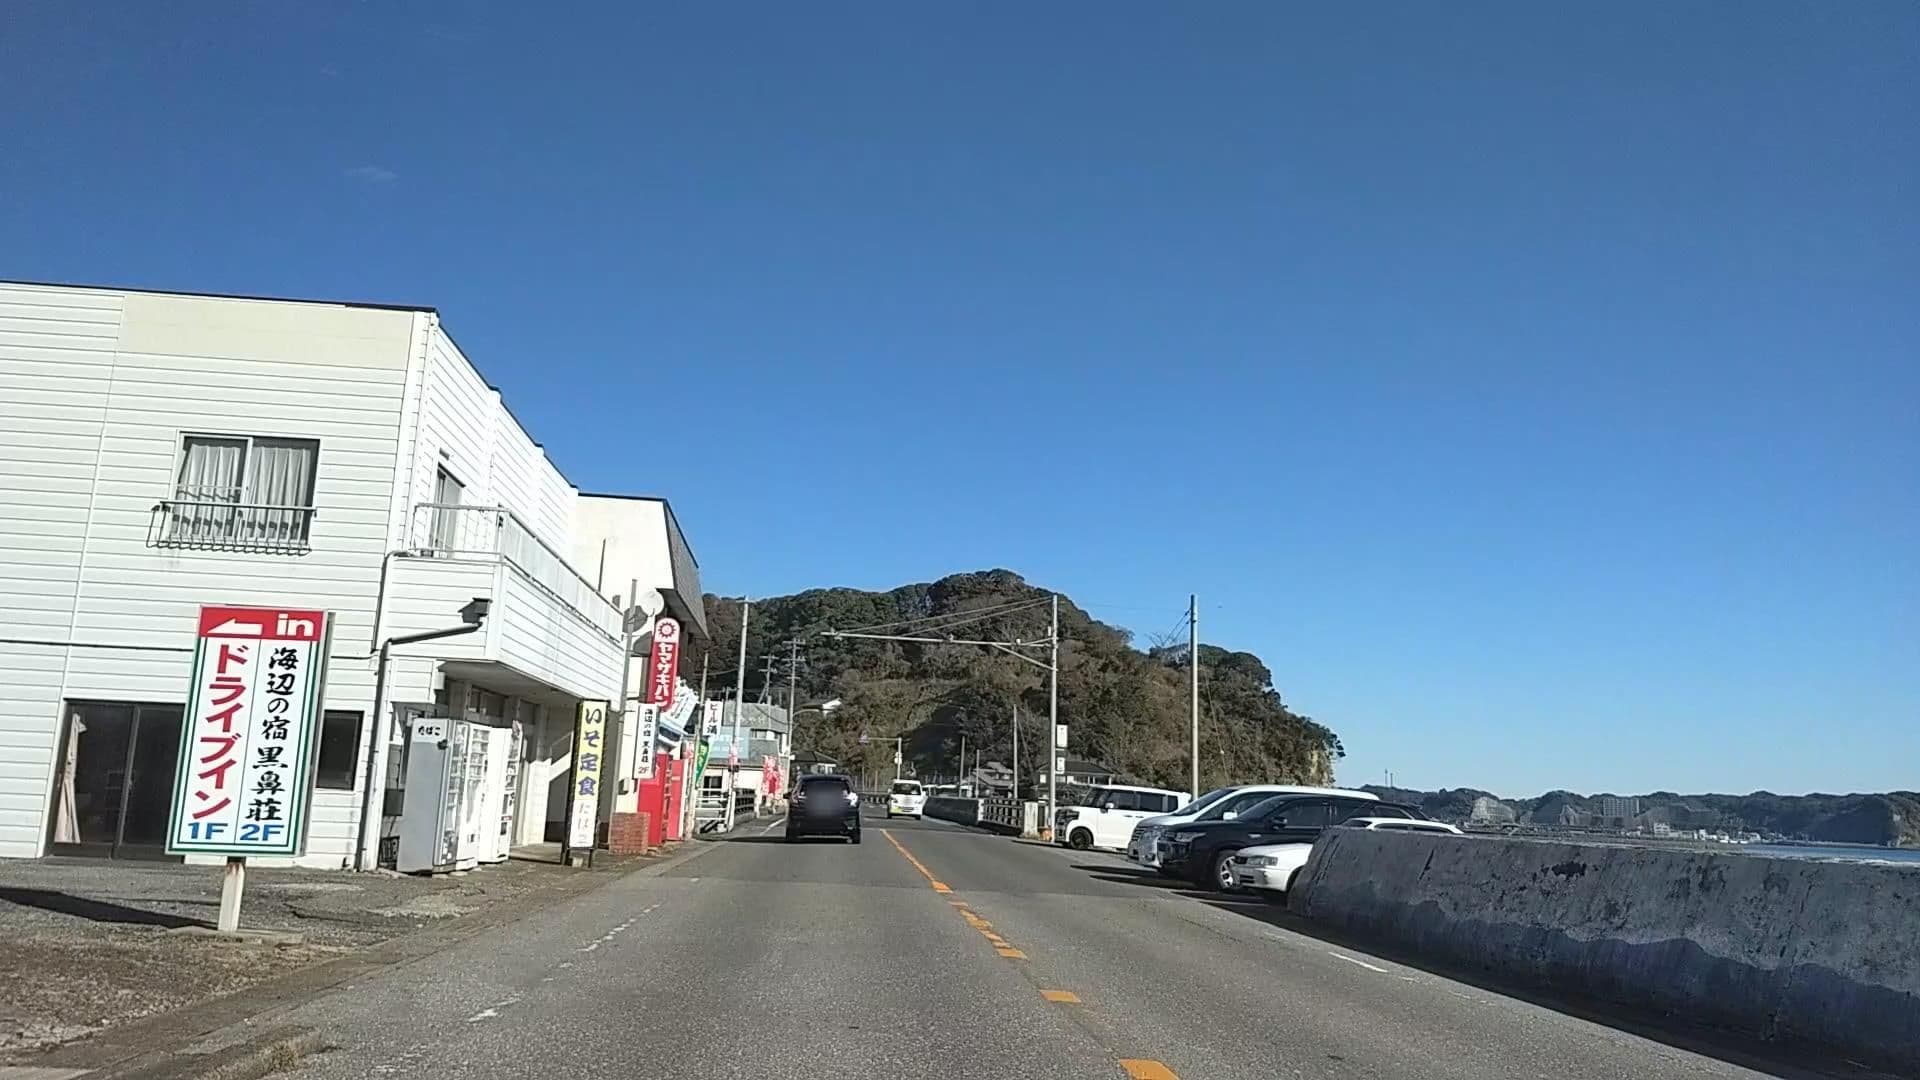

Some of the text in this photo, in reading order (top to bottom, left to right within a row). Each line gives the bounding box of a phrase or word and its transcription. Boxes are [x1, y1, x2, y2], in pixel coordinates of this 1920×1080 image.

[276, 613, 314, 636] in
[192, 644, 250, 820] ドライブイン
[578, 708, 603, 796] いそ定食
[187, 822, 229, 840] 1F
[239, 823, 285, 842] 2F
